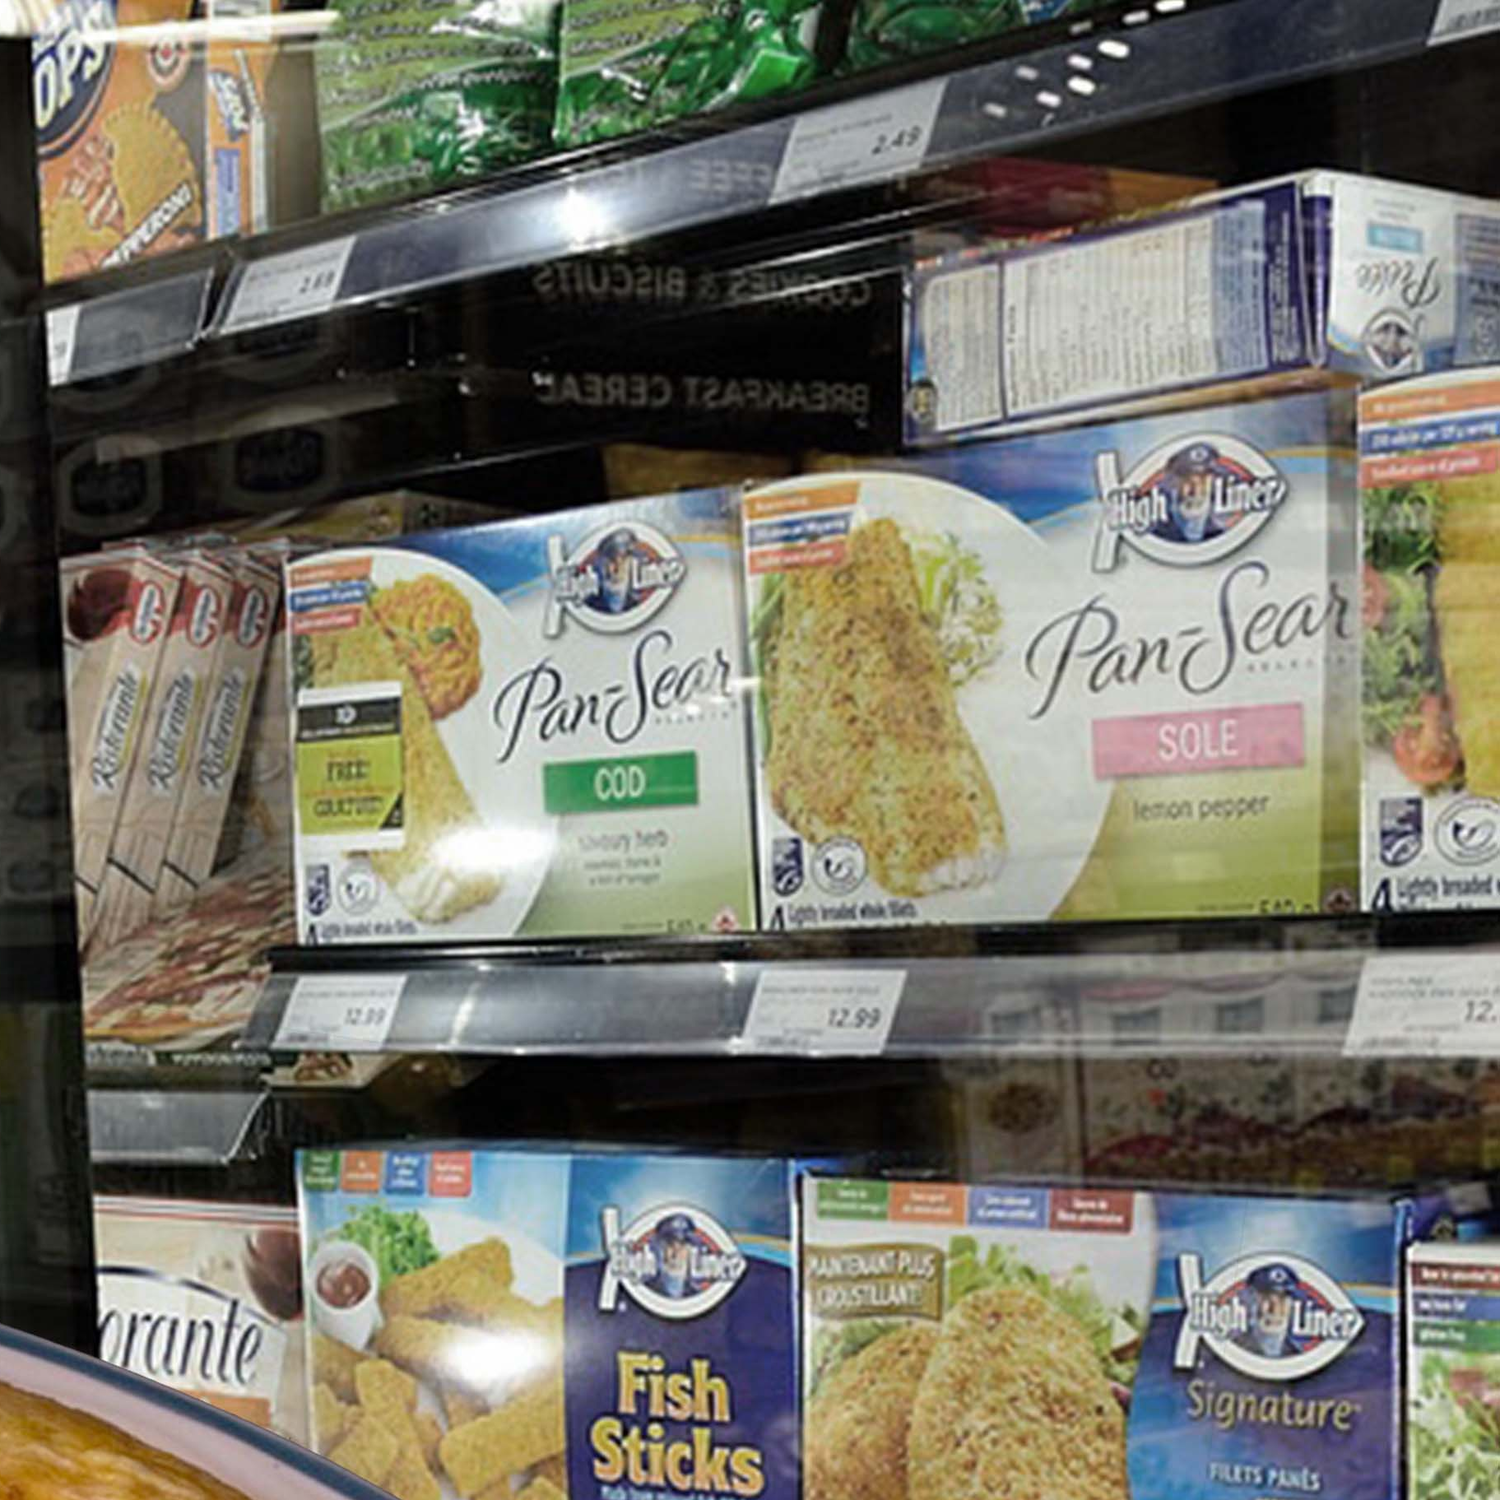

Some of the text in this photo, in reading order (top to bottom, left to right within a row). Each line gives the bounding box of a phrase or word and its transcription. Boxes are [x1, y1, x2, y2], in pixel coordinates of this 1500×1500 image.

[1107, 474, 1285, 535] High Liner
[1025, 560, 1350, 721] Pan-Sear
[493, 630, 732, 764] Pan-Sear
[1157, 718, 1240, 762] SOLE
[593, 765, 647, 802] COD
[1132, 795, 1270, 822] lemon pepper
[826, 1007, 883, 1029] 12.99
[1191, 1291, 1356, 1342] High Liner
[616, 1352, 731, 1423] Fish
[1186, 1378, 1352, 1431] Signature
[590, 1416, 766, 1497] Sticks
[1209, 1461, 1263, 1486] FILETS
